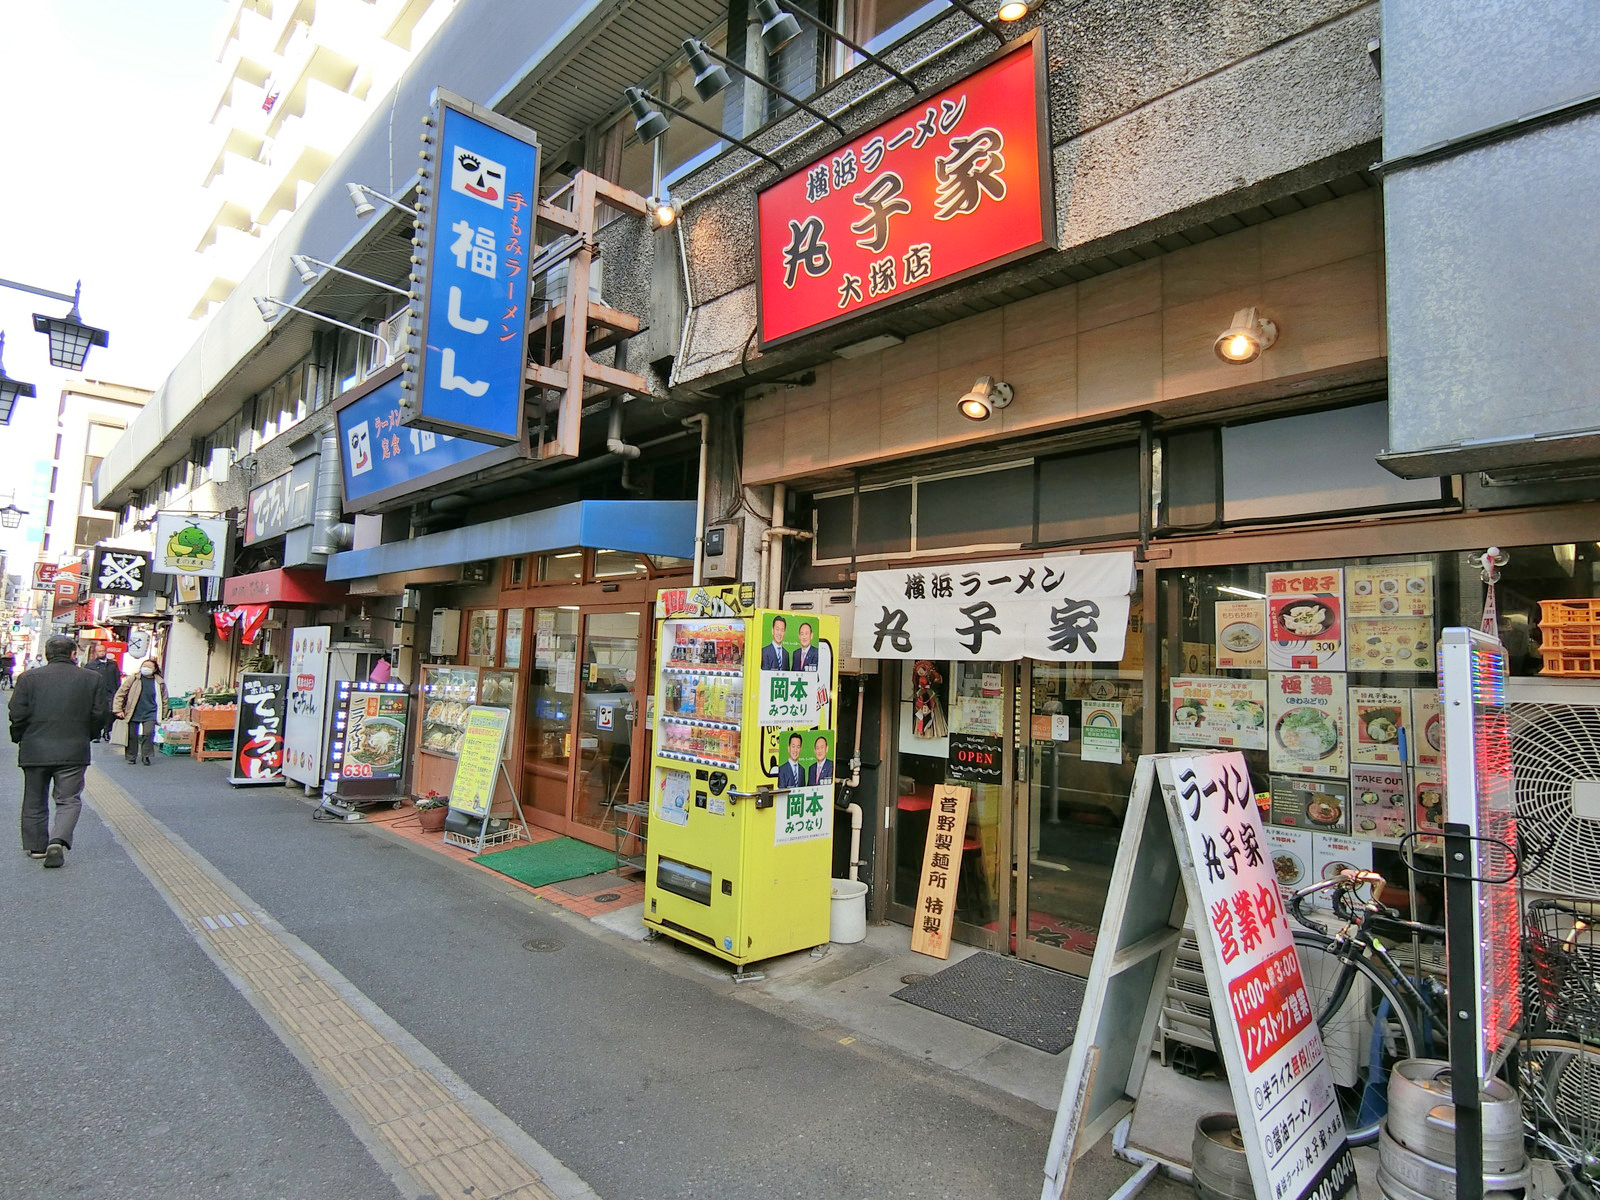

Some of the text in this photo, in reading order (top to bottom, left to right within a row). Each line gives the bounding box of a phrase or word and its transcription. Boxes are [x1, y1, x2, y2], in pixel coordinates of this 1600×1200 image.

[806, 95, 967, 203] 横浜ラーメン
[782, 127, 1007, 288] 丸子家
[499, 191, 529, 343] 手もみラーメン
[838, 243, 931, 308] 大塚店
[439, 220, 499, 398] 福しん
[905, 566, 1066, 600] 横浜ラーメン
[1271, 575, 1336, 594] 茹で餃子
[873, 597, 1101, 655] 丸子家
[1315, 642, 1335, 652] 300
[768, 703, 808, 717] みつなり
[770, 677, 809, 703] 岡本
[244, 692, 283, 778] てっちゃん
[958, 749, 993, 764] OPEN
[343, 764, 371, 778] 630
[1178, 765, 1250, 821] ラーメン
[1354, 774, 1383, 784] TAKE
[785, 818, 823, 834] みつなり
[786, 792, 824, 819] 岡本
[921, 796, 958, 936] 菅野製麺所 特製
[1201, 822, 1264, 884] 丸子家
[1210, 878, 1289, 966] 営業中!
[1245, 987, 1311, 1061] ノンストップ営業
